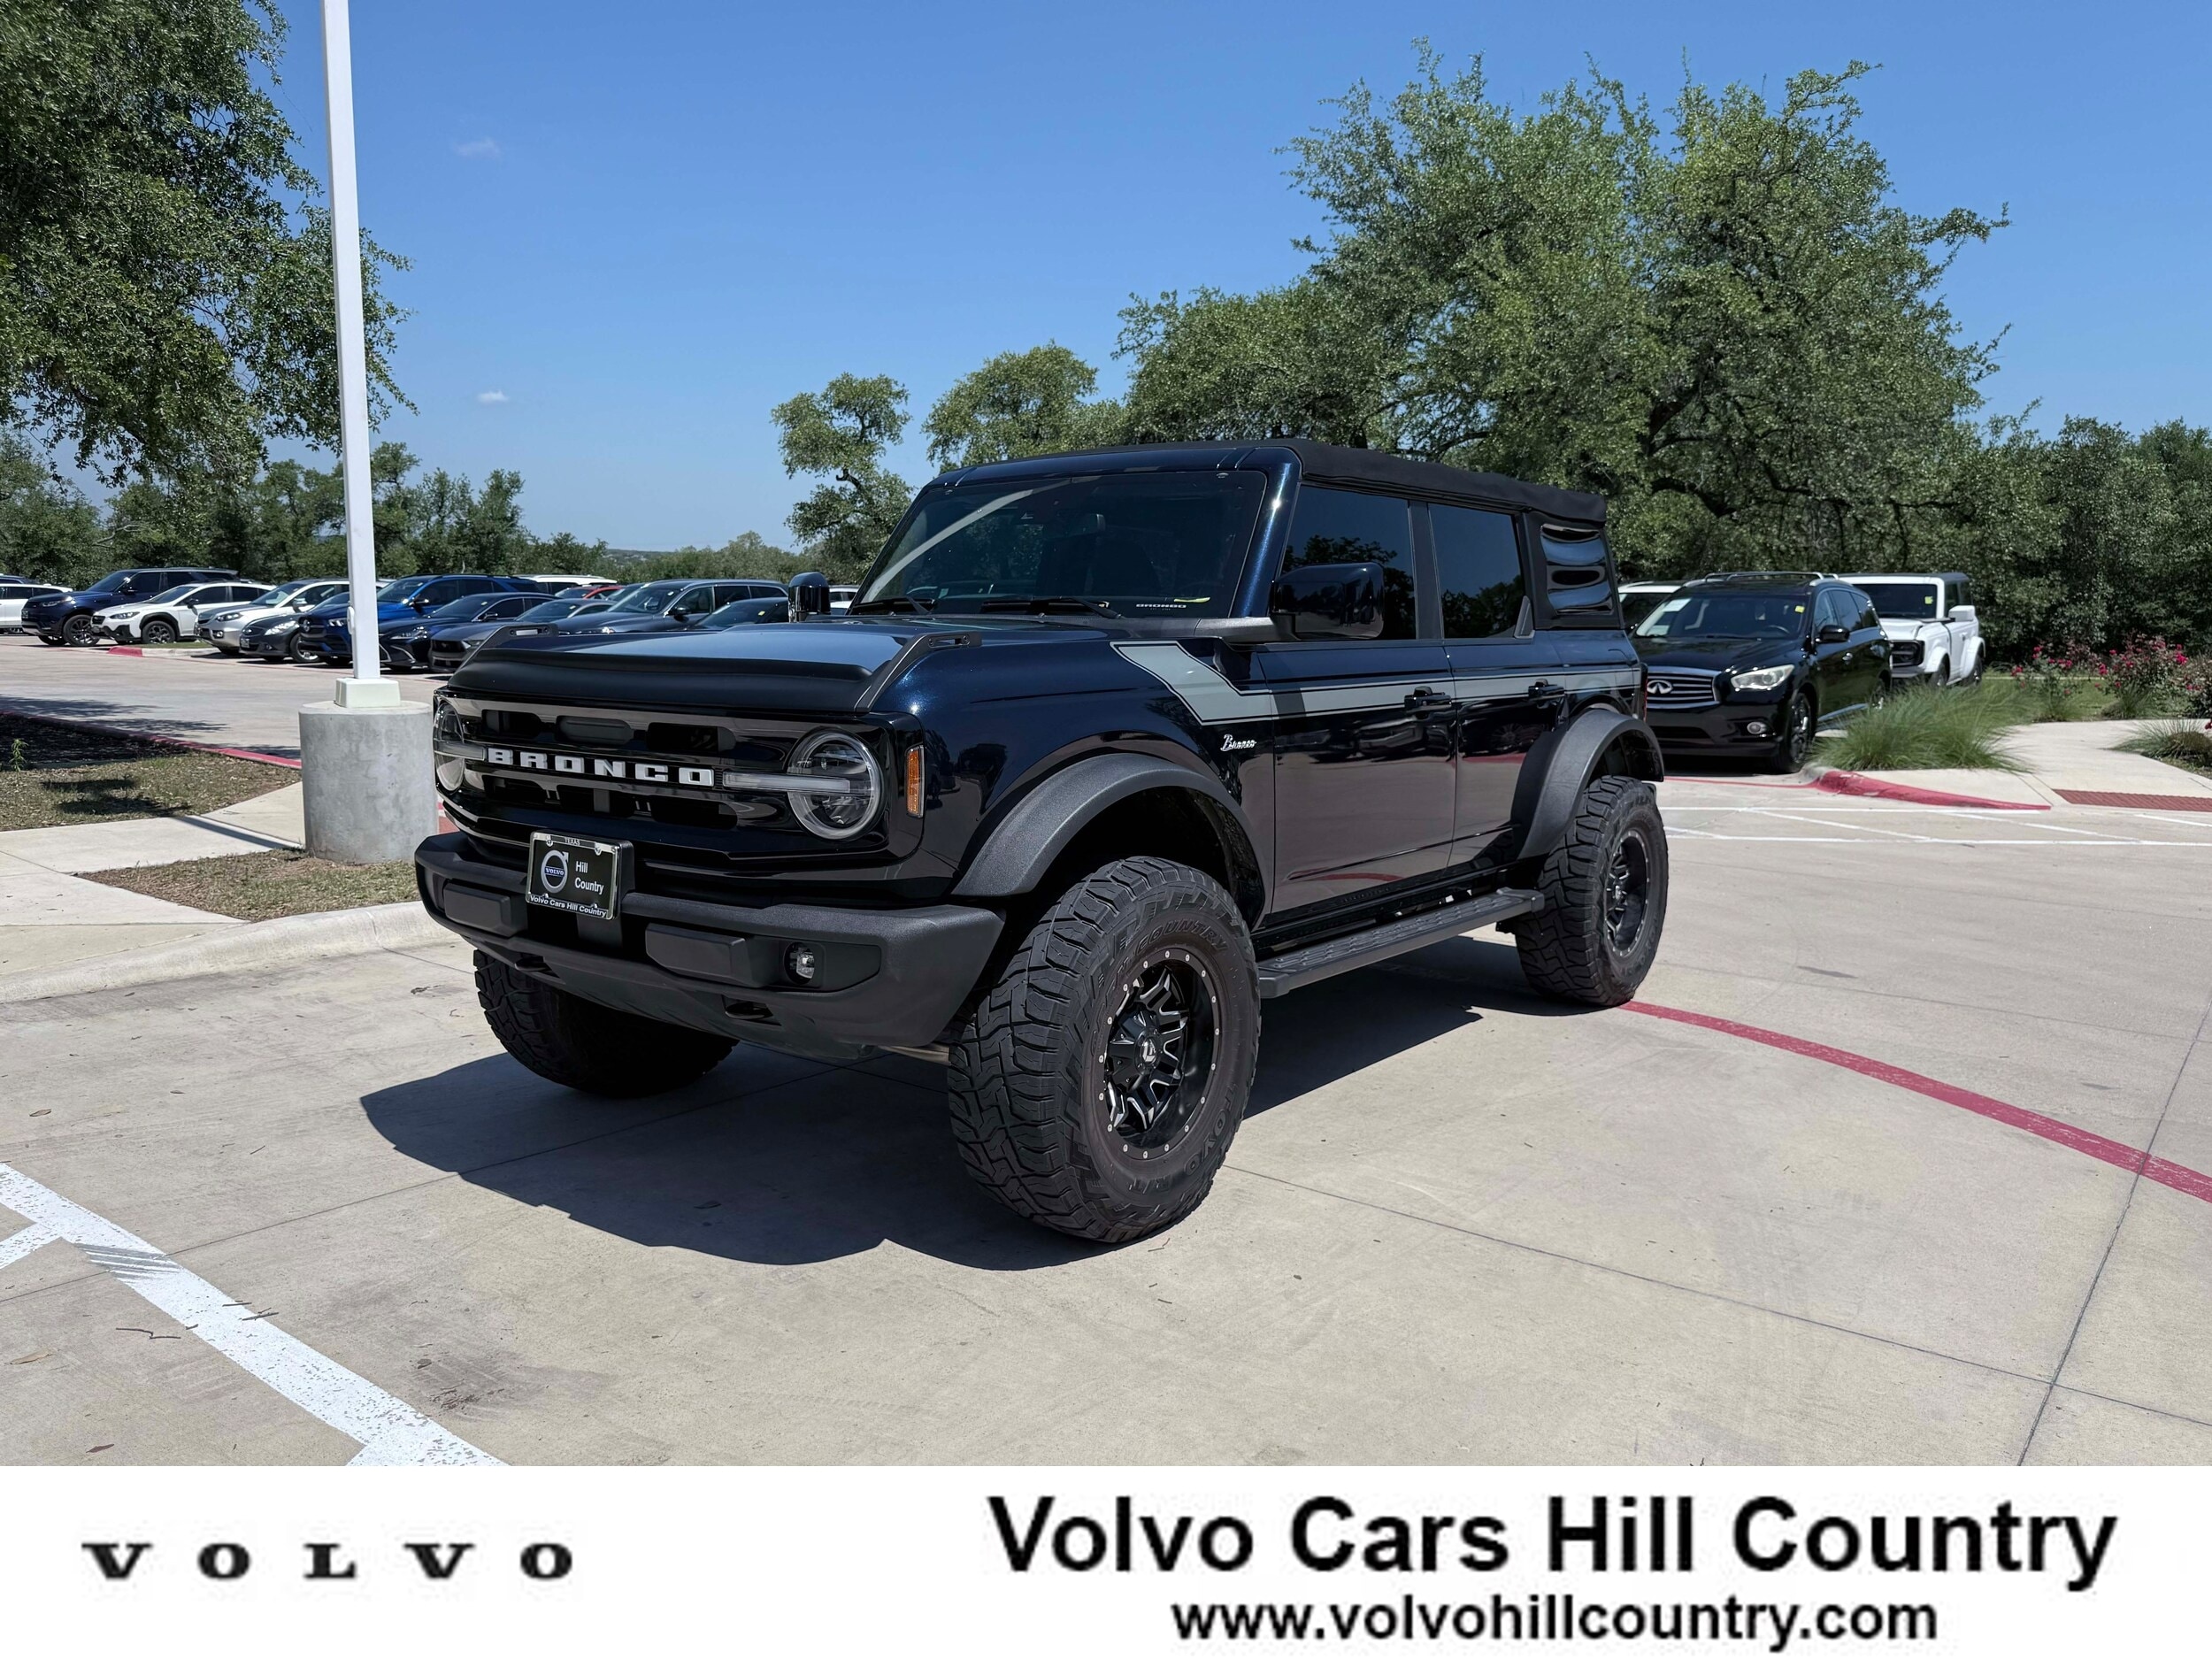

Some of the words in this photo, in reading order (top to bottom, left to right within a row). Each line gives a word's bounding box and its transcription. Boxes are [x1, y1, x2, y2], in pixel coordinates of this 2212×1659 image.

[487, 747, 715, 787] BRONCO
[565, 837, 581, 847] TEXAS
[575, 861, 588, 873] Hill
[574, 877, 604, 895] Country
[529, 895, 549, 905] Volvo
[549, 900, 566, 909] Cars
[566, 902, 578, 911] Hill
[580, 906, 607, 918] Country
[1135, 918, 1228, 956] COUNTRY
